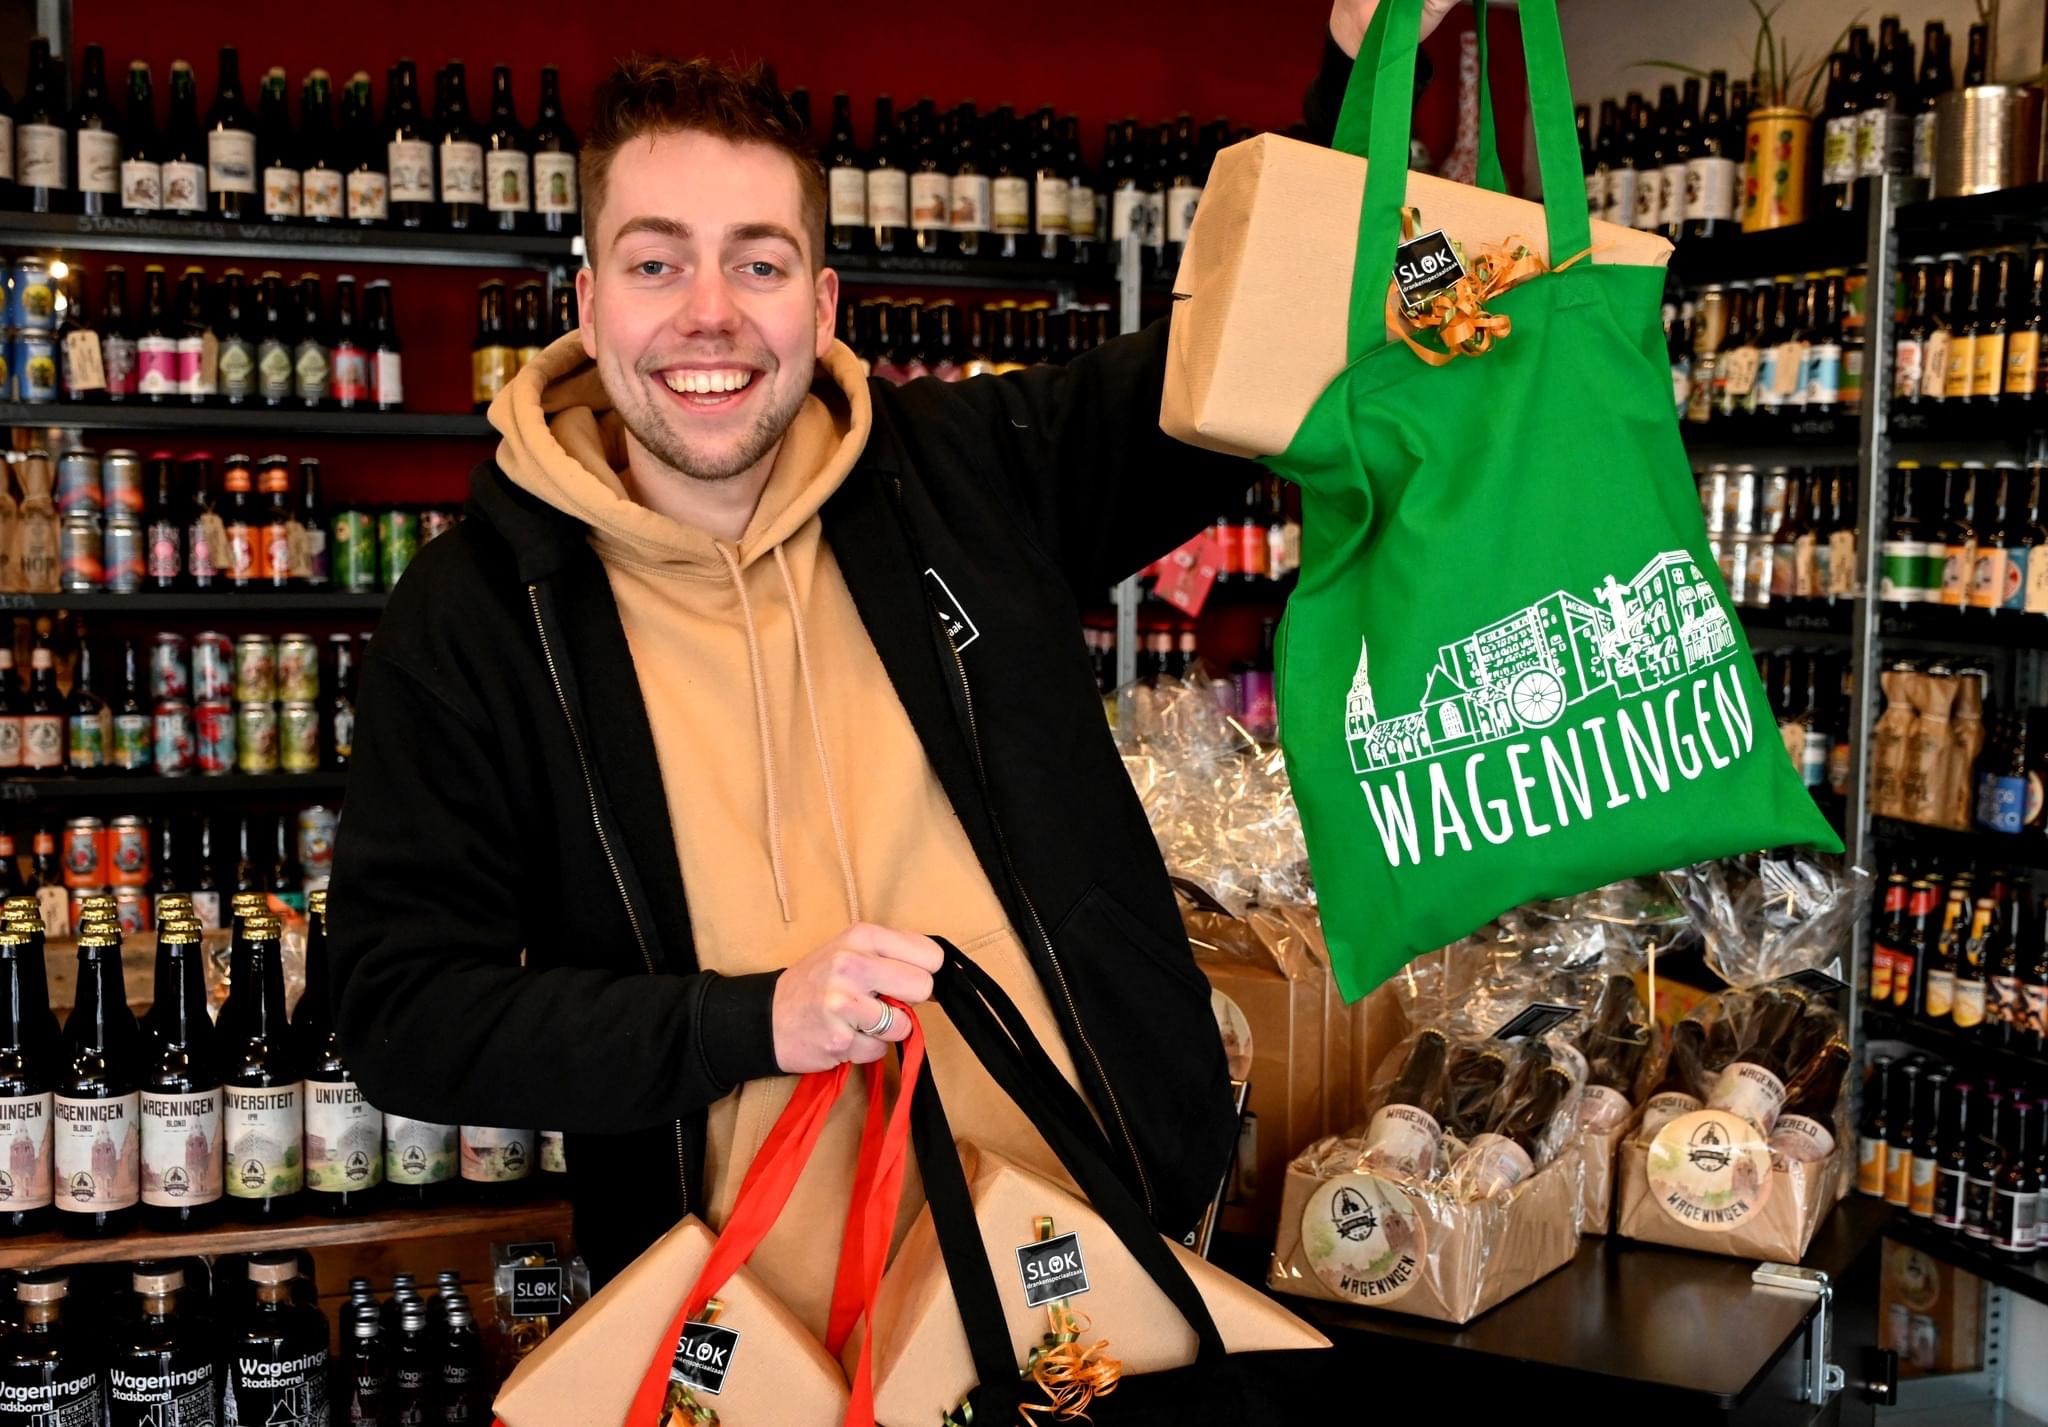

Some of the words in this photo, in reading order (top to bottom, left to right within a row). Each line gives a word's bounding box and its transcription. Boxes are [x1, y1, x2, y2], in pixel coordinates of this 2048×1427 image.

[1399, 248, 1452, 284] SLOK
[1403, 262, 1458, 292] drankenspeciaalzaak
[1360, 664, 1754, 867] WAGENINGEN
[225, 1091, 295, 1112] NIVERSITEIT
[316, 1088, 366, 1104] UNIVER
[0, 1101, 42, 1121] INGEN
[143, 1097, 214, 1117] WAGENINGEN
[1666, 1192, 1750, 1223] WAGENINGEN
[1027, 1251, 1078, 1281] SLOK
[1340, 1255, 1416, 1297] WAGENINGEN
[1026, 1269, 1083, 1289] drankenspeciaalzaak
[517, 1282, 557, 1297] SLOK
[110, 1363, 213, 1391] Wageningen
[242, 1373, 304, 1389] Stadsborrel
[112, 1388, 173, 1402] Stadsborrel
[0, 1400, 54, 1413] adsborrel
